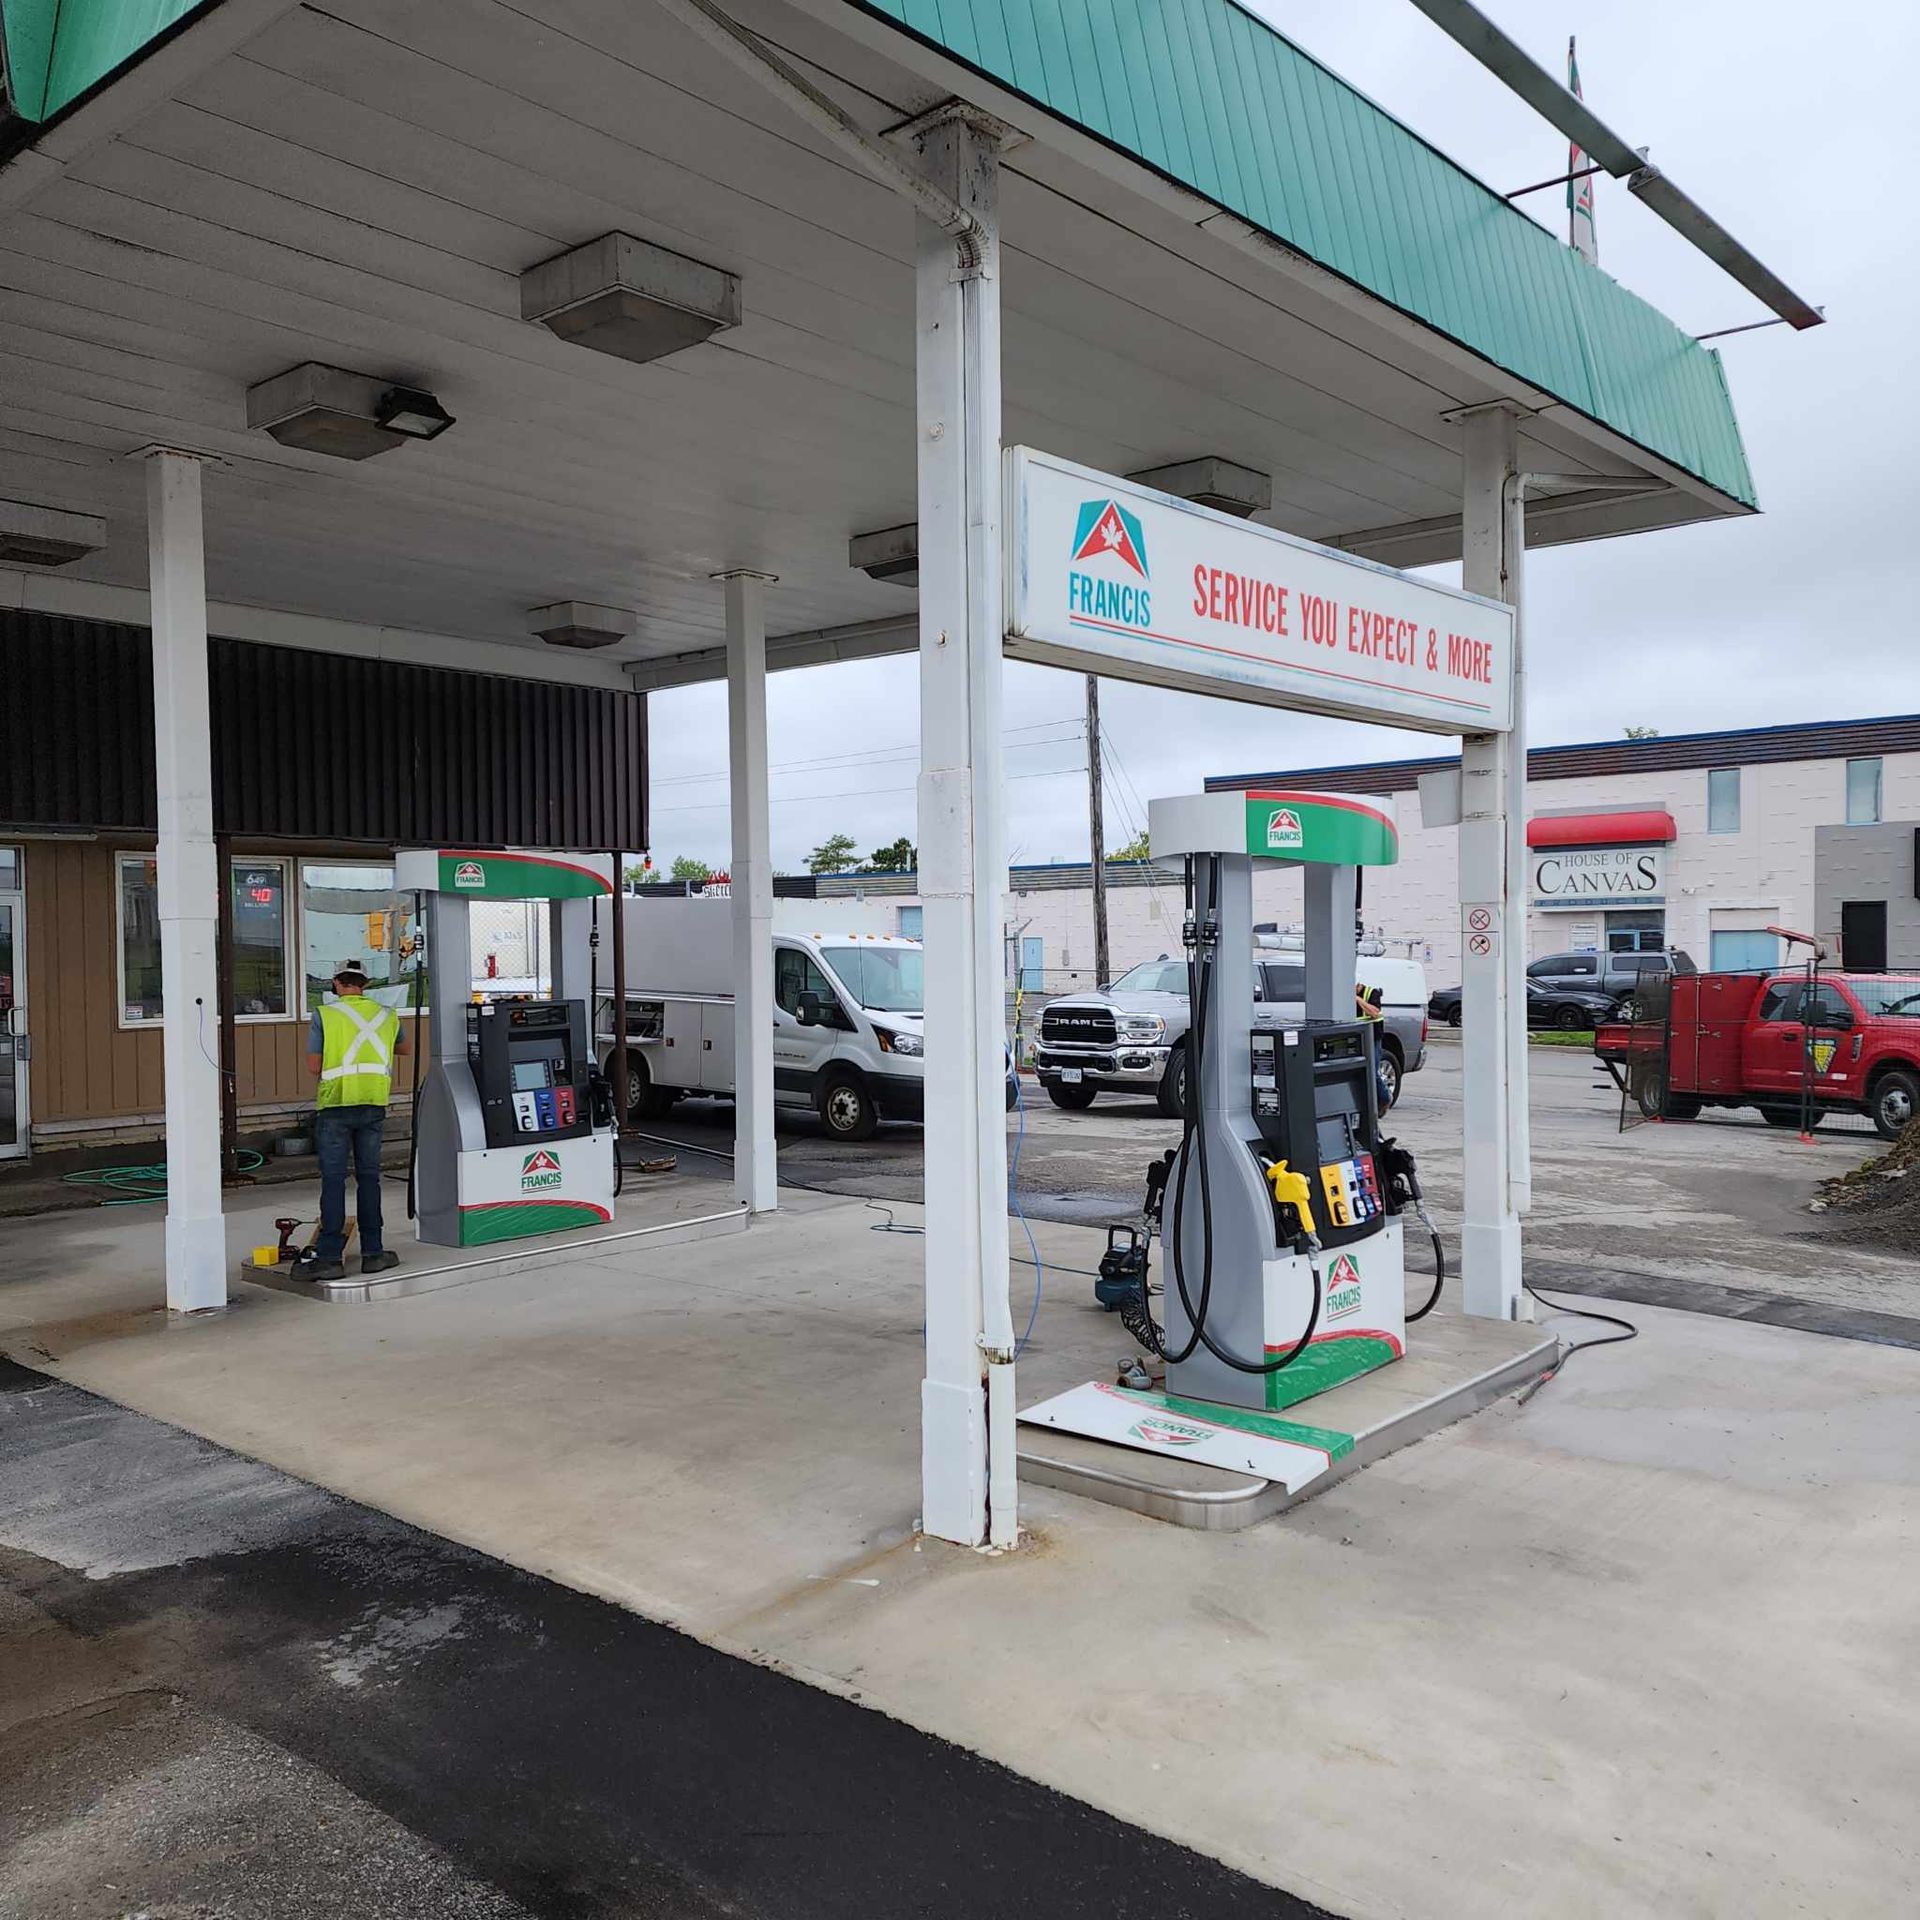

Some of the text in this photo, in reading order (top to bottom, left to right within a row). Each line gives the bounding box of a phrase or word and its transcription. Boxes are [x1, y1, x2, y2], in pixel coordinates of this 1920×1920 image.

[1069, 571, 1151, 628] FRANCIS
[1193, 563, 1493, 685] SERVICE YOU EXPECT & MORE
[1269, 831, 1301, 841] FRANCIS
[1564, 852, 1634, 868] HOUSE OF
[1536, 855, 1657, 895] CANVAS
[251, 887, 273, 903] 40
[1060, 1018, 1091, 1026] RAM
[521, 1171, 562, 1189] FRANCIS
[1326, 1286, 1361, 1315] FRANCIS
